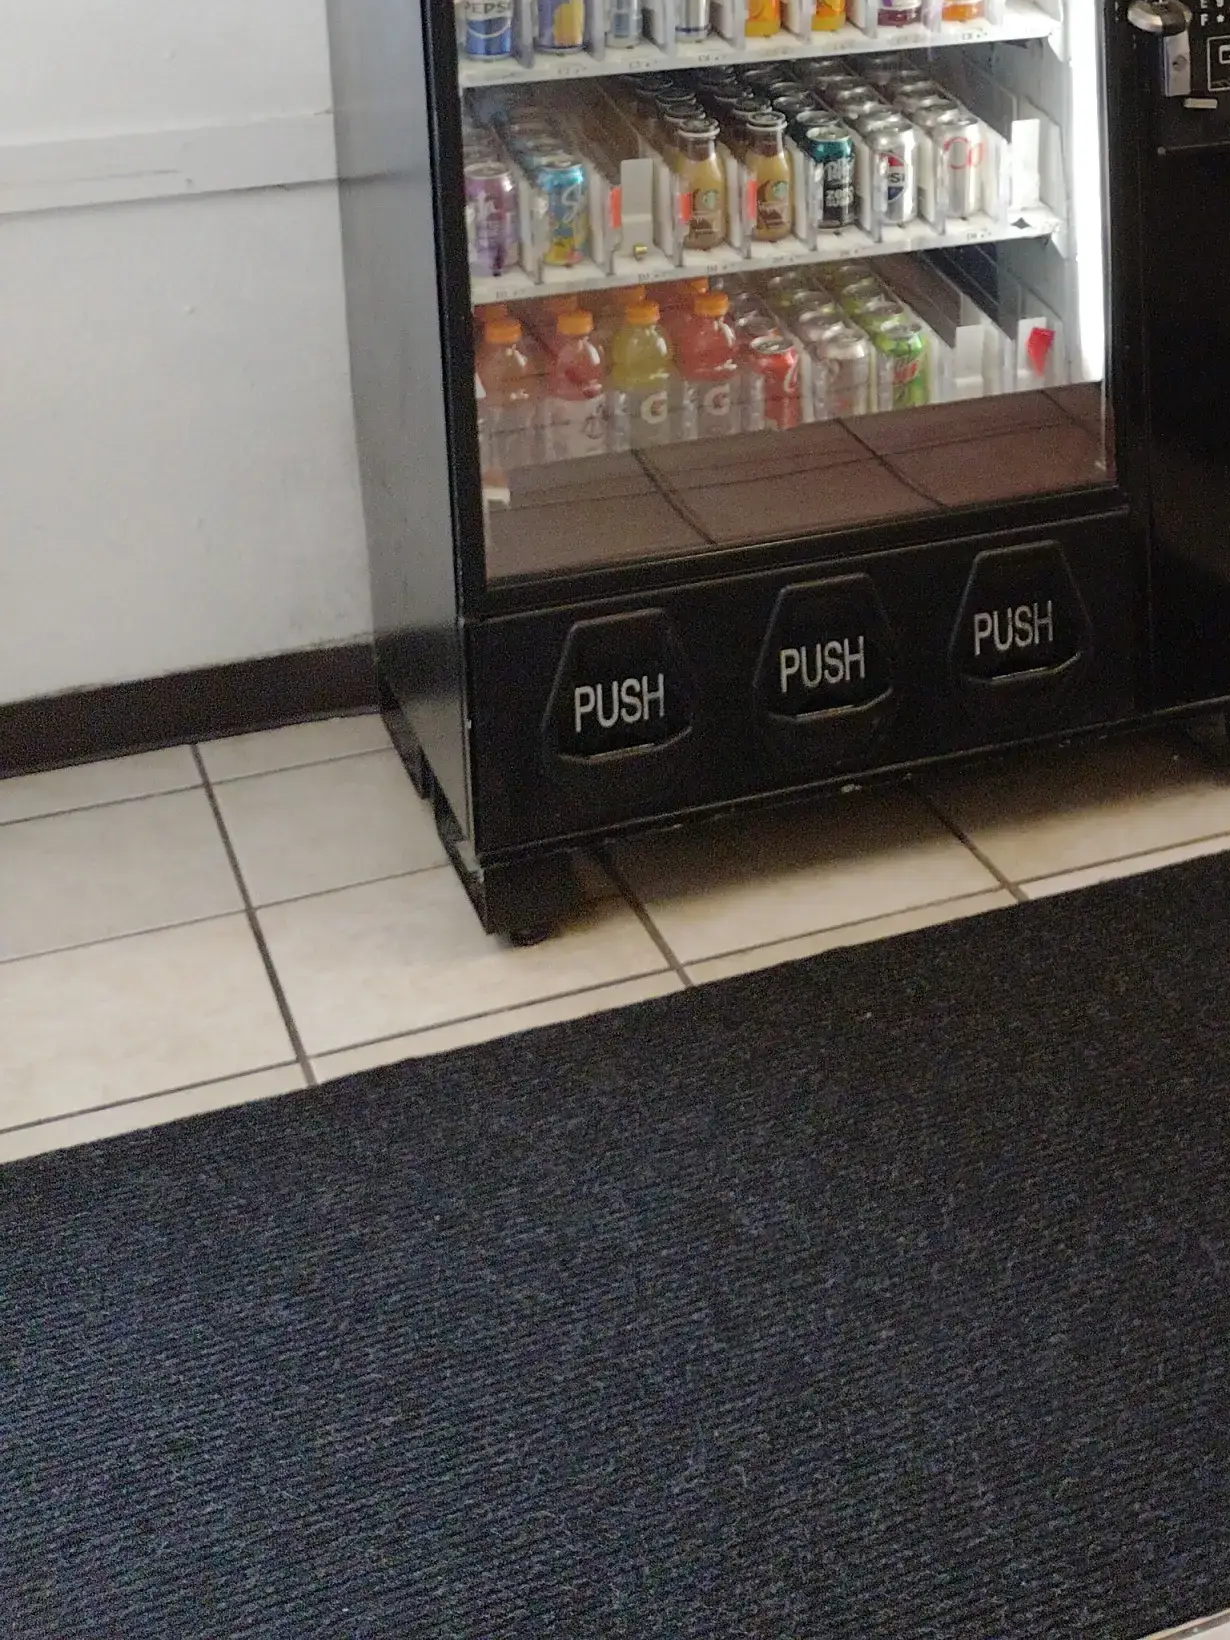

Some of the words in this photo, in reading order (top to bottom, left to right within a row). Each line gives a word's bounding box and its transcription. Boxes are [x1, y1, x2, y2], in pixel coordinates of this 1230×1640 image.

[1200, 13, 1209, 26] F
[973, 600, 1054, 656] PUSH
[780, 635, 866, 693] PUSH
[574, 673, 665, 733] PUSH
